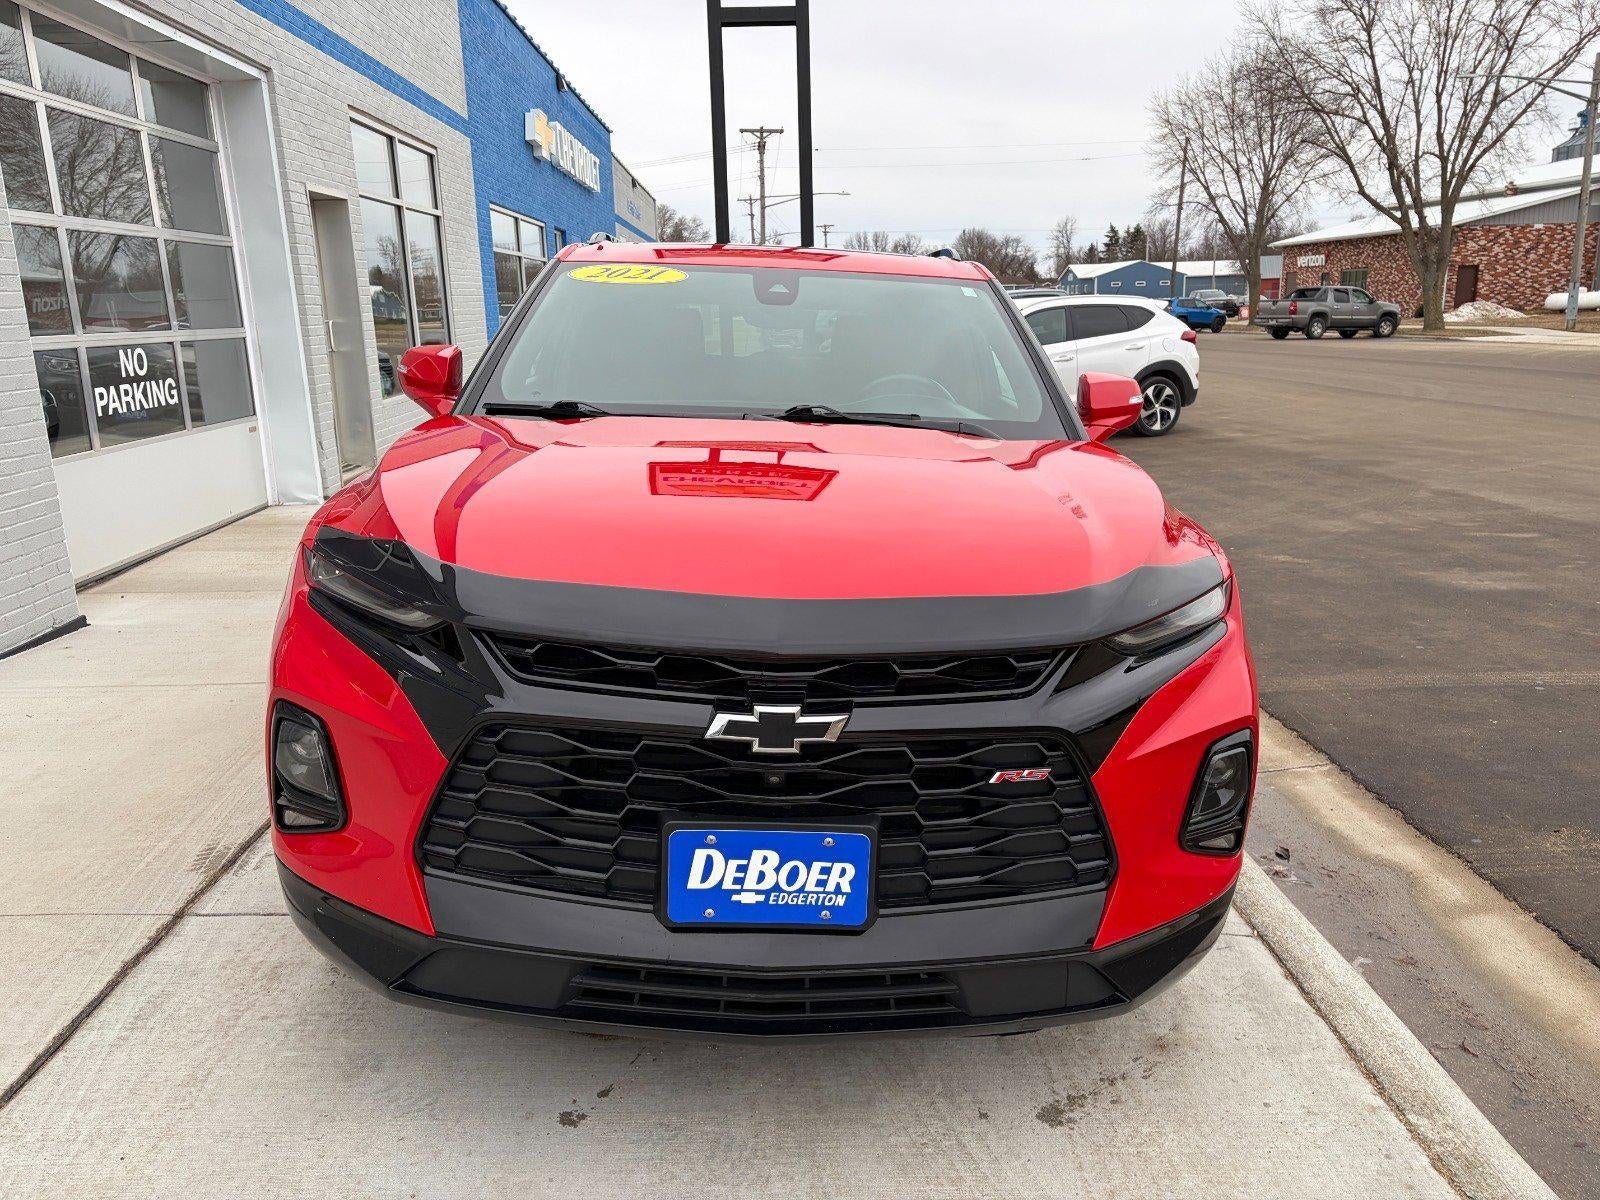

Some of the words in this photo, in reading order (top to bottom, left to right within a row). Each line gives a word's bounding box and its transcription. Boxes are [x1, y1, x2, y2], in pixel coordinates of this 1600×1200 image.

[1297, 254, 1326, 267] verizon
[586, 266, 669, 280] 2021
[118, 347, 148, 378] NO
[94, 377, 179, 417] PARKING
[989, 768, 1052, 784] RS
[769, 892, 847, 907] EDGERTON
